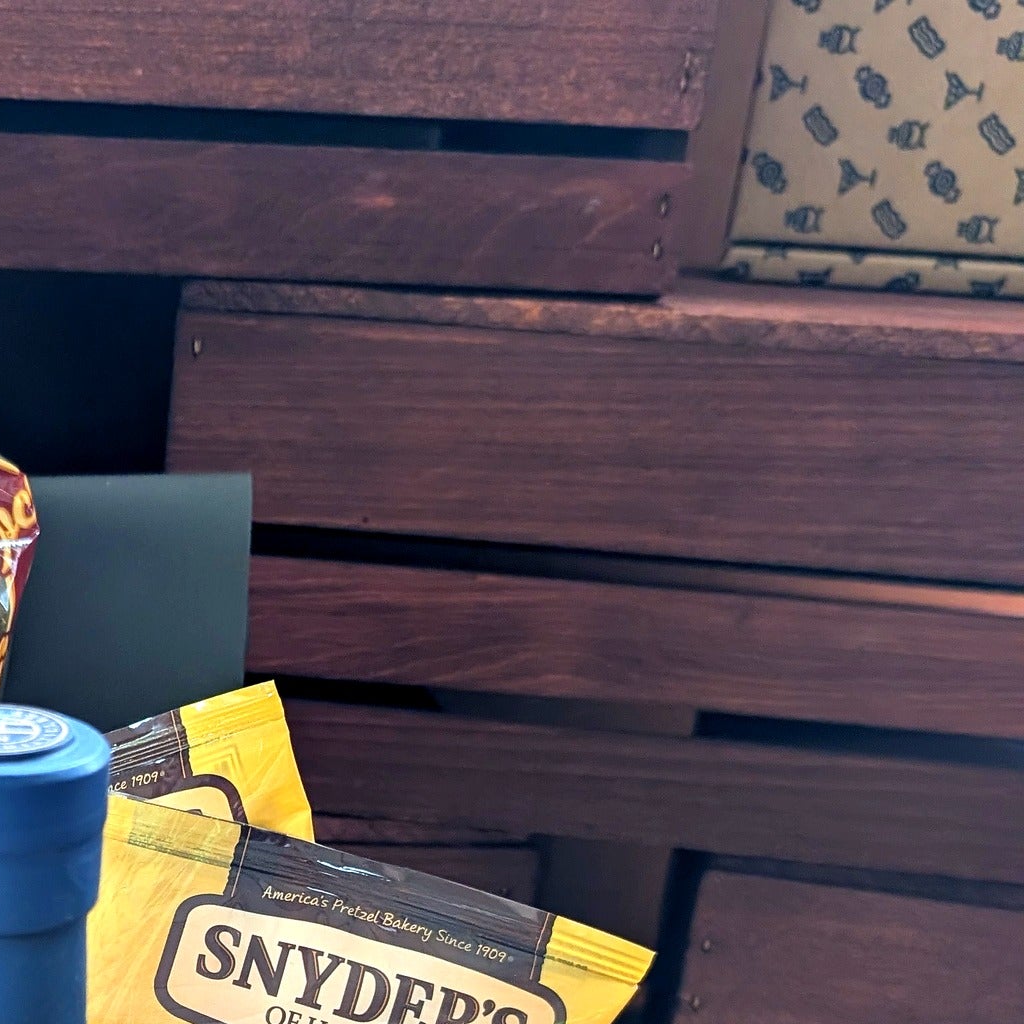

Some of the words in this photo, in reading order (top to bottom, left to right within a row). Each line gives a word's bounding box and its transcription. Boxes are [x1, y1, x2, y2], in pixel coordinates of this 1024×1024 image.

[131, 771, 159, 788] 1909
[261, 885, 328, 908] America's
[332, 900, 382, 924] Pretzel
[382, 911, 433, 941] Bakery
[435, 928, 472, 952] Since
[476, 944, 507, 963] 1909
